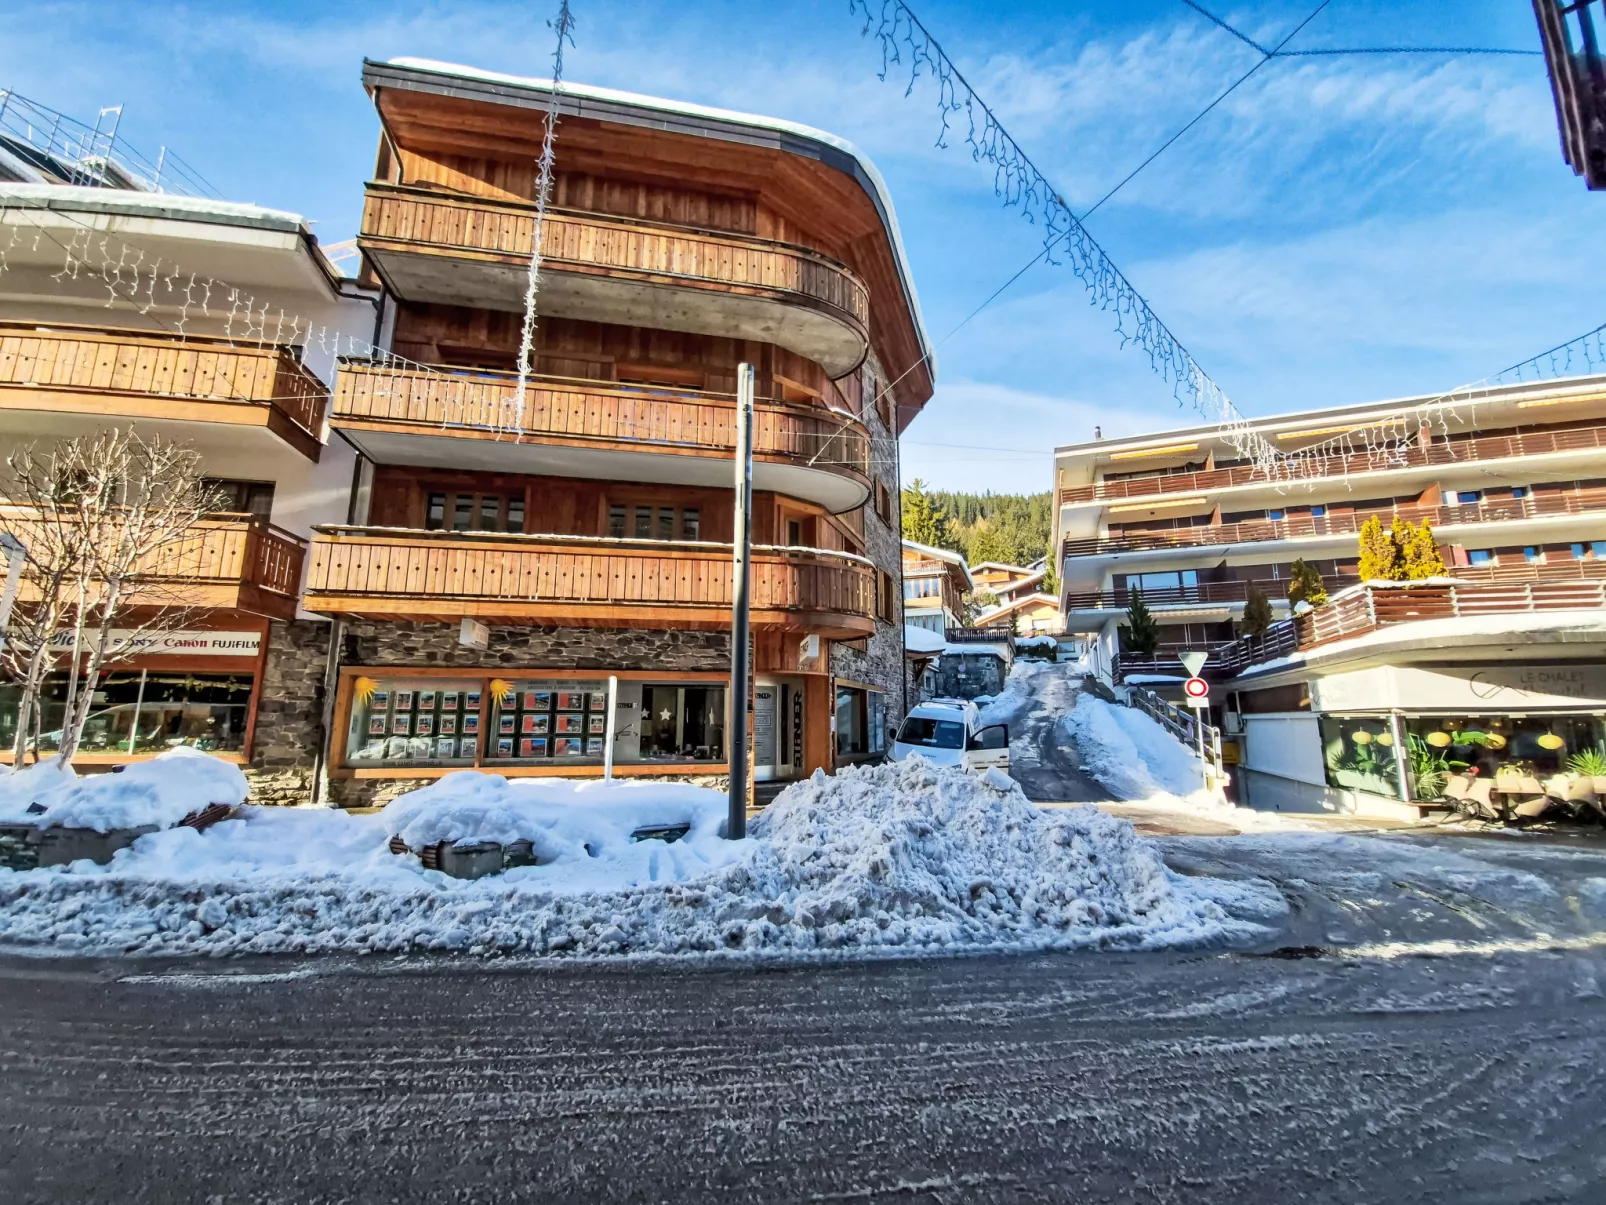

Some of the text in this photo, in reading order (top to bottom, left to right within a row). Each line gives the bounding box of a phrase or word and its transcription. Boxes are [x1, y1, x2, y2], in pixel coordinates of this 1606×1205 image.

[164, 637, 208, 648] Canon
[211, 639, 261, 649] FUJIFILM
[1521, 671, 1585, 682] LE CHALET
